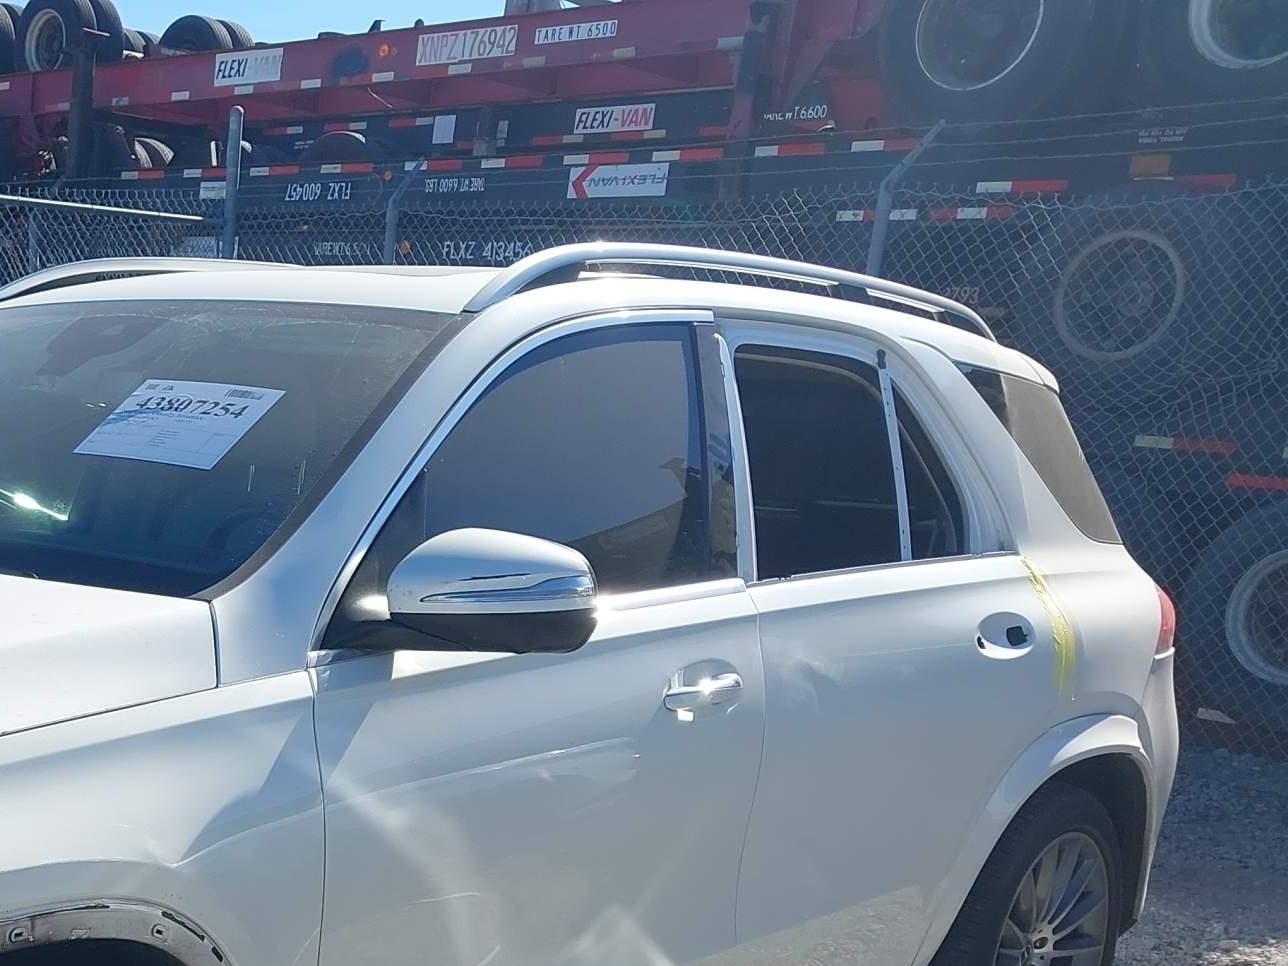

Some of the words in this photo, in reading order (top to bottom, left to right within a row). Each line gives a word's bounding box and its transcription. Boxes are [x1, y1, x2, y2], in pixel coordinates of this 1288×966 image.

[537, 28, 562, 43] TARE
[568, 26, 580, 40] WT
[587, 22, 616, 38] 6500
[575, 107, 653, 130] FLEXI-VAN
[285, 183, 321, 201] 600457
[327, 182, 351, 200] FLXZ
[470, 177, 484, 191] TARE
[442, 240, 475, 259] FLXZ
[136, 396, 249, 418] 43807254
